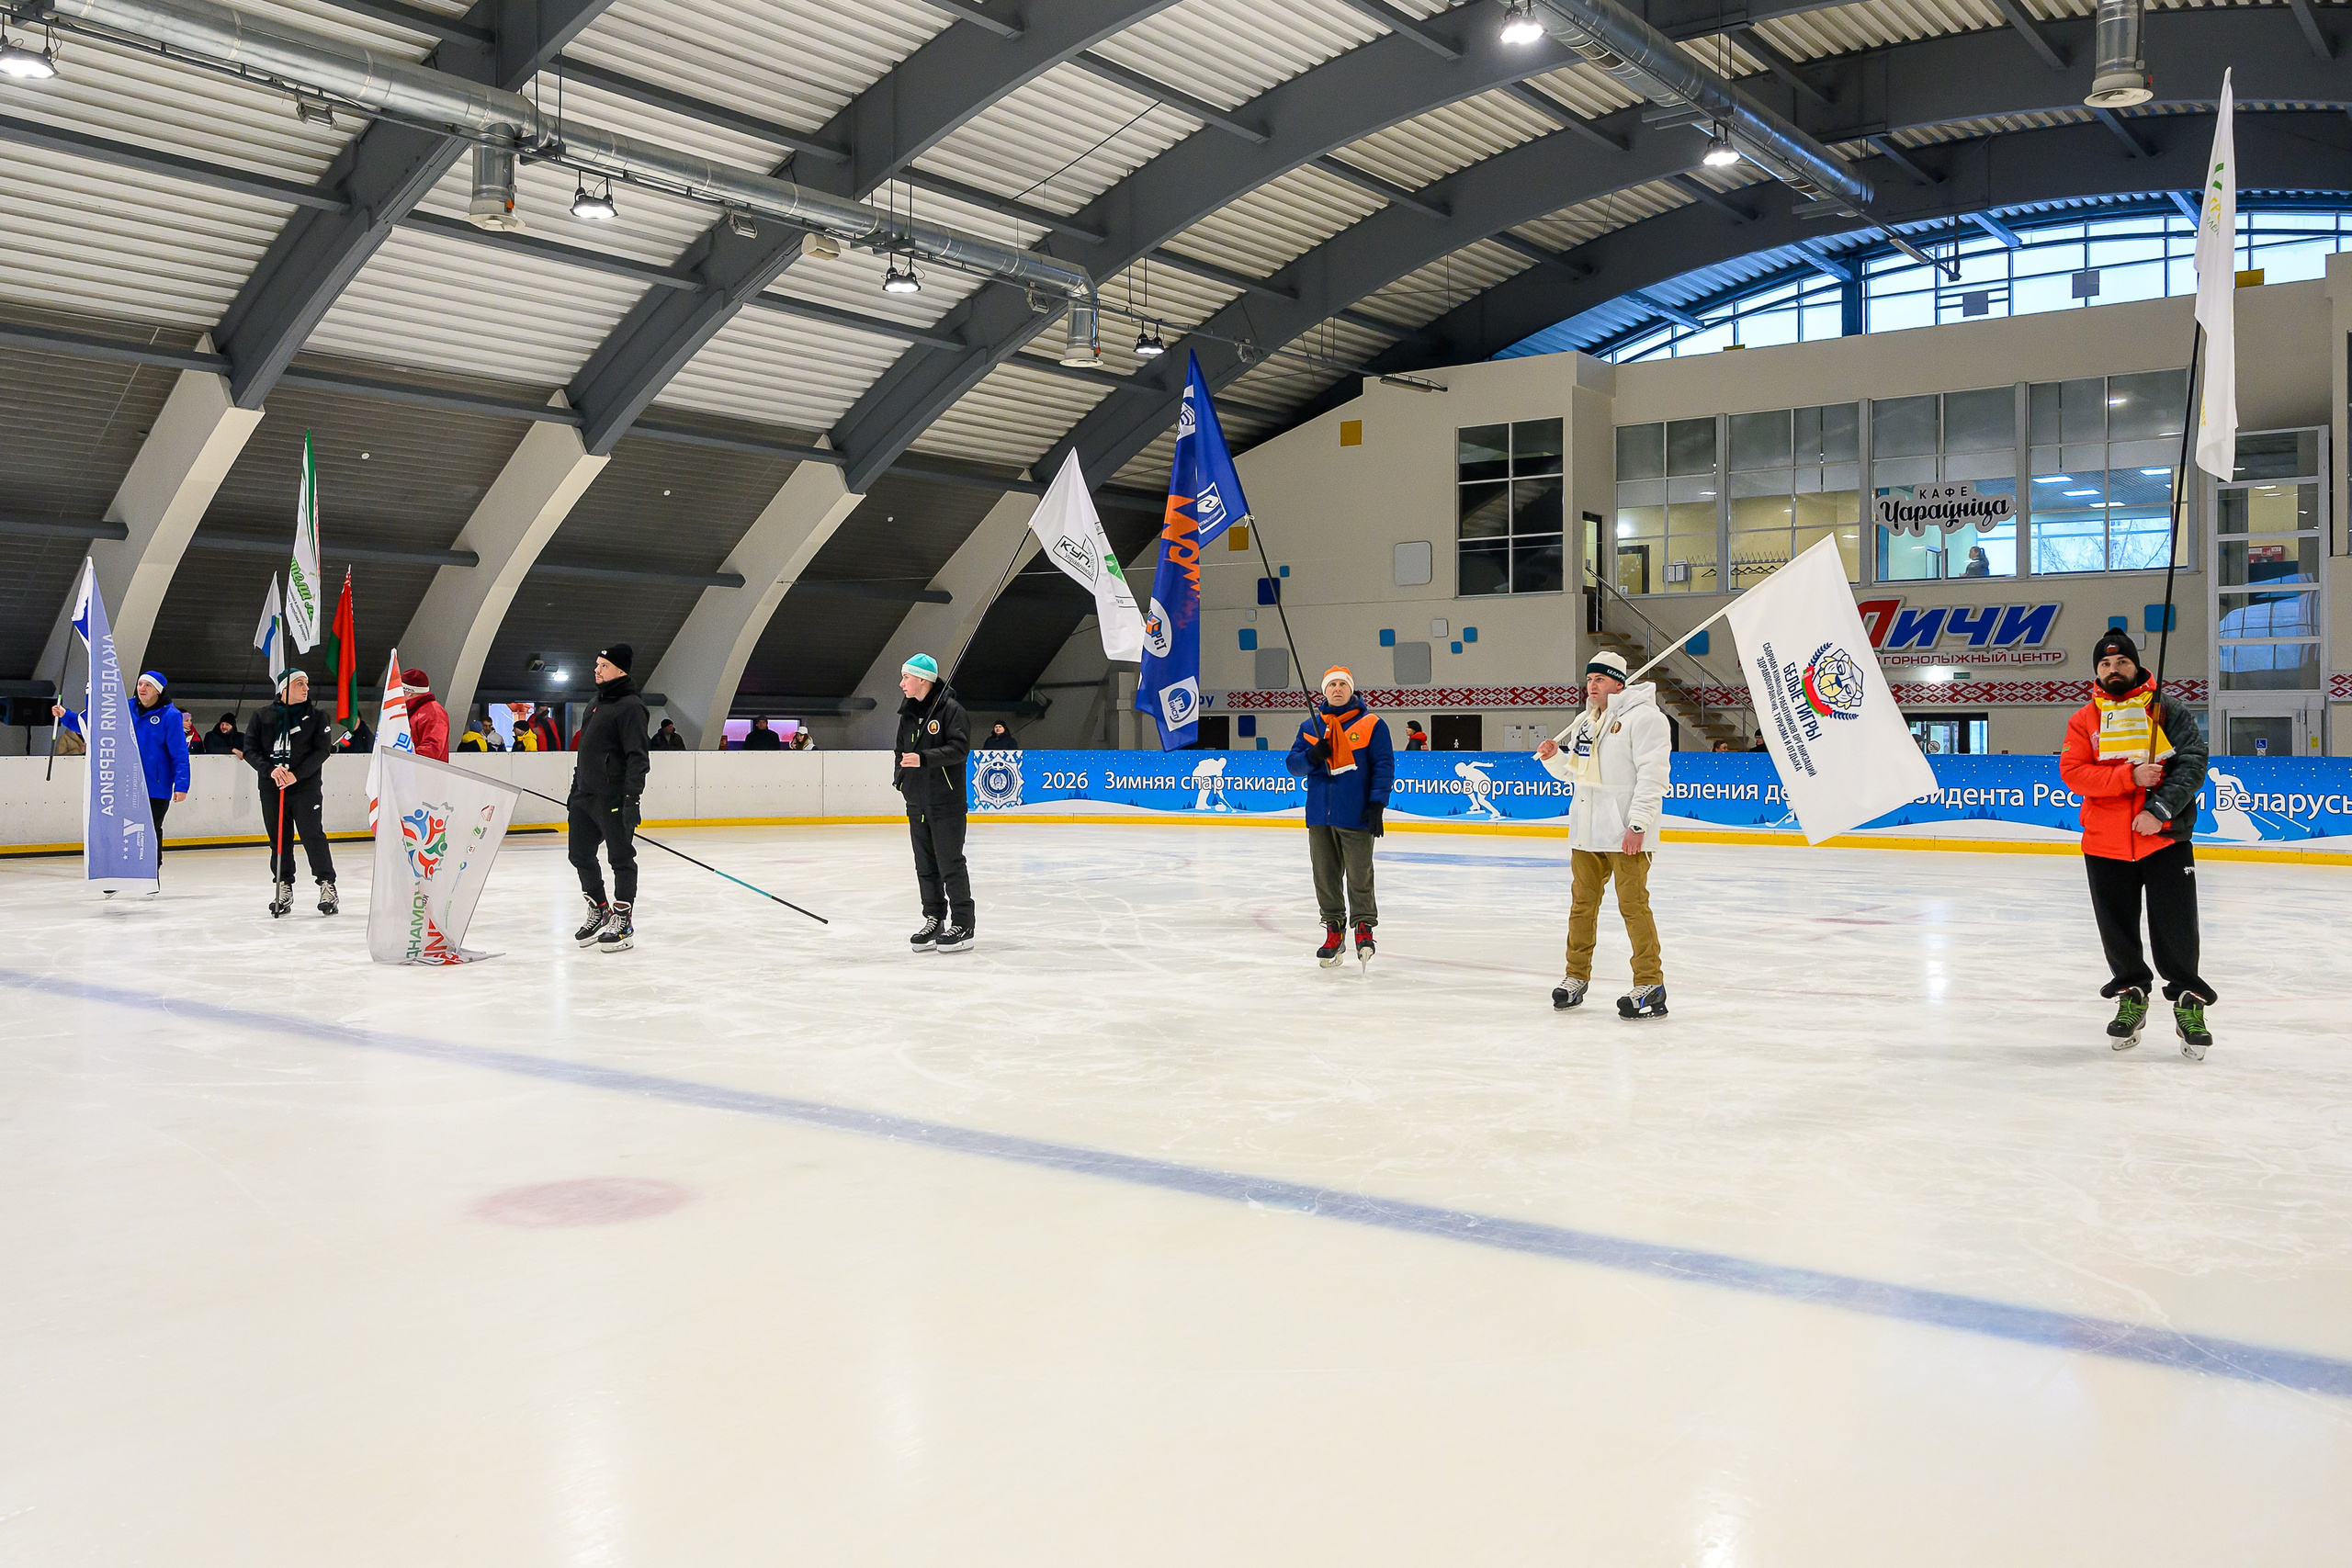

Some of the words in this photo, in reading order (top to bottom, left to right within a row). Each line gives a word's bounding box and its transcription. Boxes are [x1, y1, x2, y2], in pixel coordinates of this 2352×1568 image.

[1919, 485, 1968, 500] КАФЕ
[1880, 498, 2010, 530] Чараўніца
[1883, 651, 2007, 664] ГОРНОЛЫЖНЫЙ
[2010, 651, 2063, 665] ЦЕНТР
[1762, 642, 1777, 670] СБОРНАЯ
[1772, 669, 1783, 697] КОМАНДА
[1778, 695, 1796, 734] РАБОТНИКОВ
[1792, 733, 1818, 777] ОРГАНИЗАЦИЙ
[1782, 661, 1806, 703] БЕЛЫЕ
[1795, 701, 1823, 742] ТИГРЫ
[1773, 712, 1789, 740] ТУРИЗМА
[1785, 745, 1803, 772] ОТДЫХА
[1041, 772, 1089, 789] 2026
[1104, 772, 1176, 790] Зимняя
[1181, 774, 1295, 794] спартакиада
[1391, 778, 1474, 795] отников
[1478, 780, 1574, 798] организа
[1663, 783, 1758, 800] авления
[1907, 786, 2024, 809] зидента
[2215, 785, 2352, 820] Беларусь
